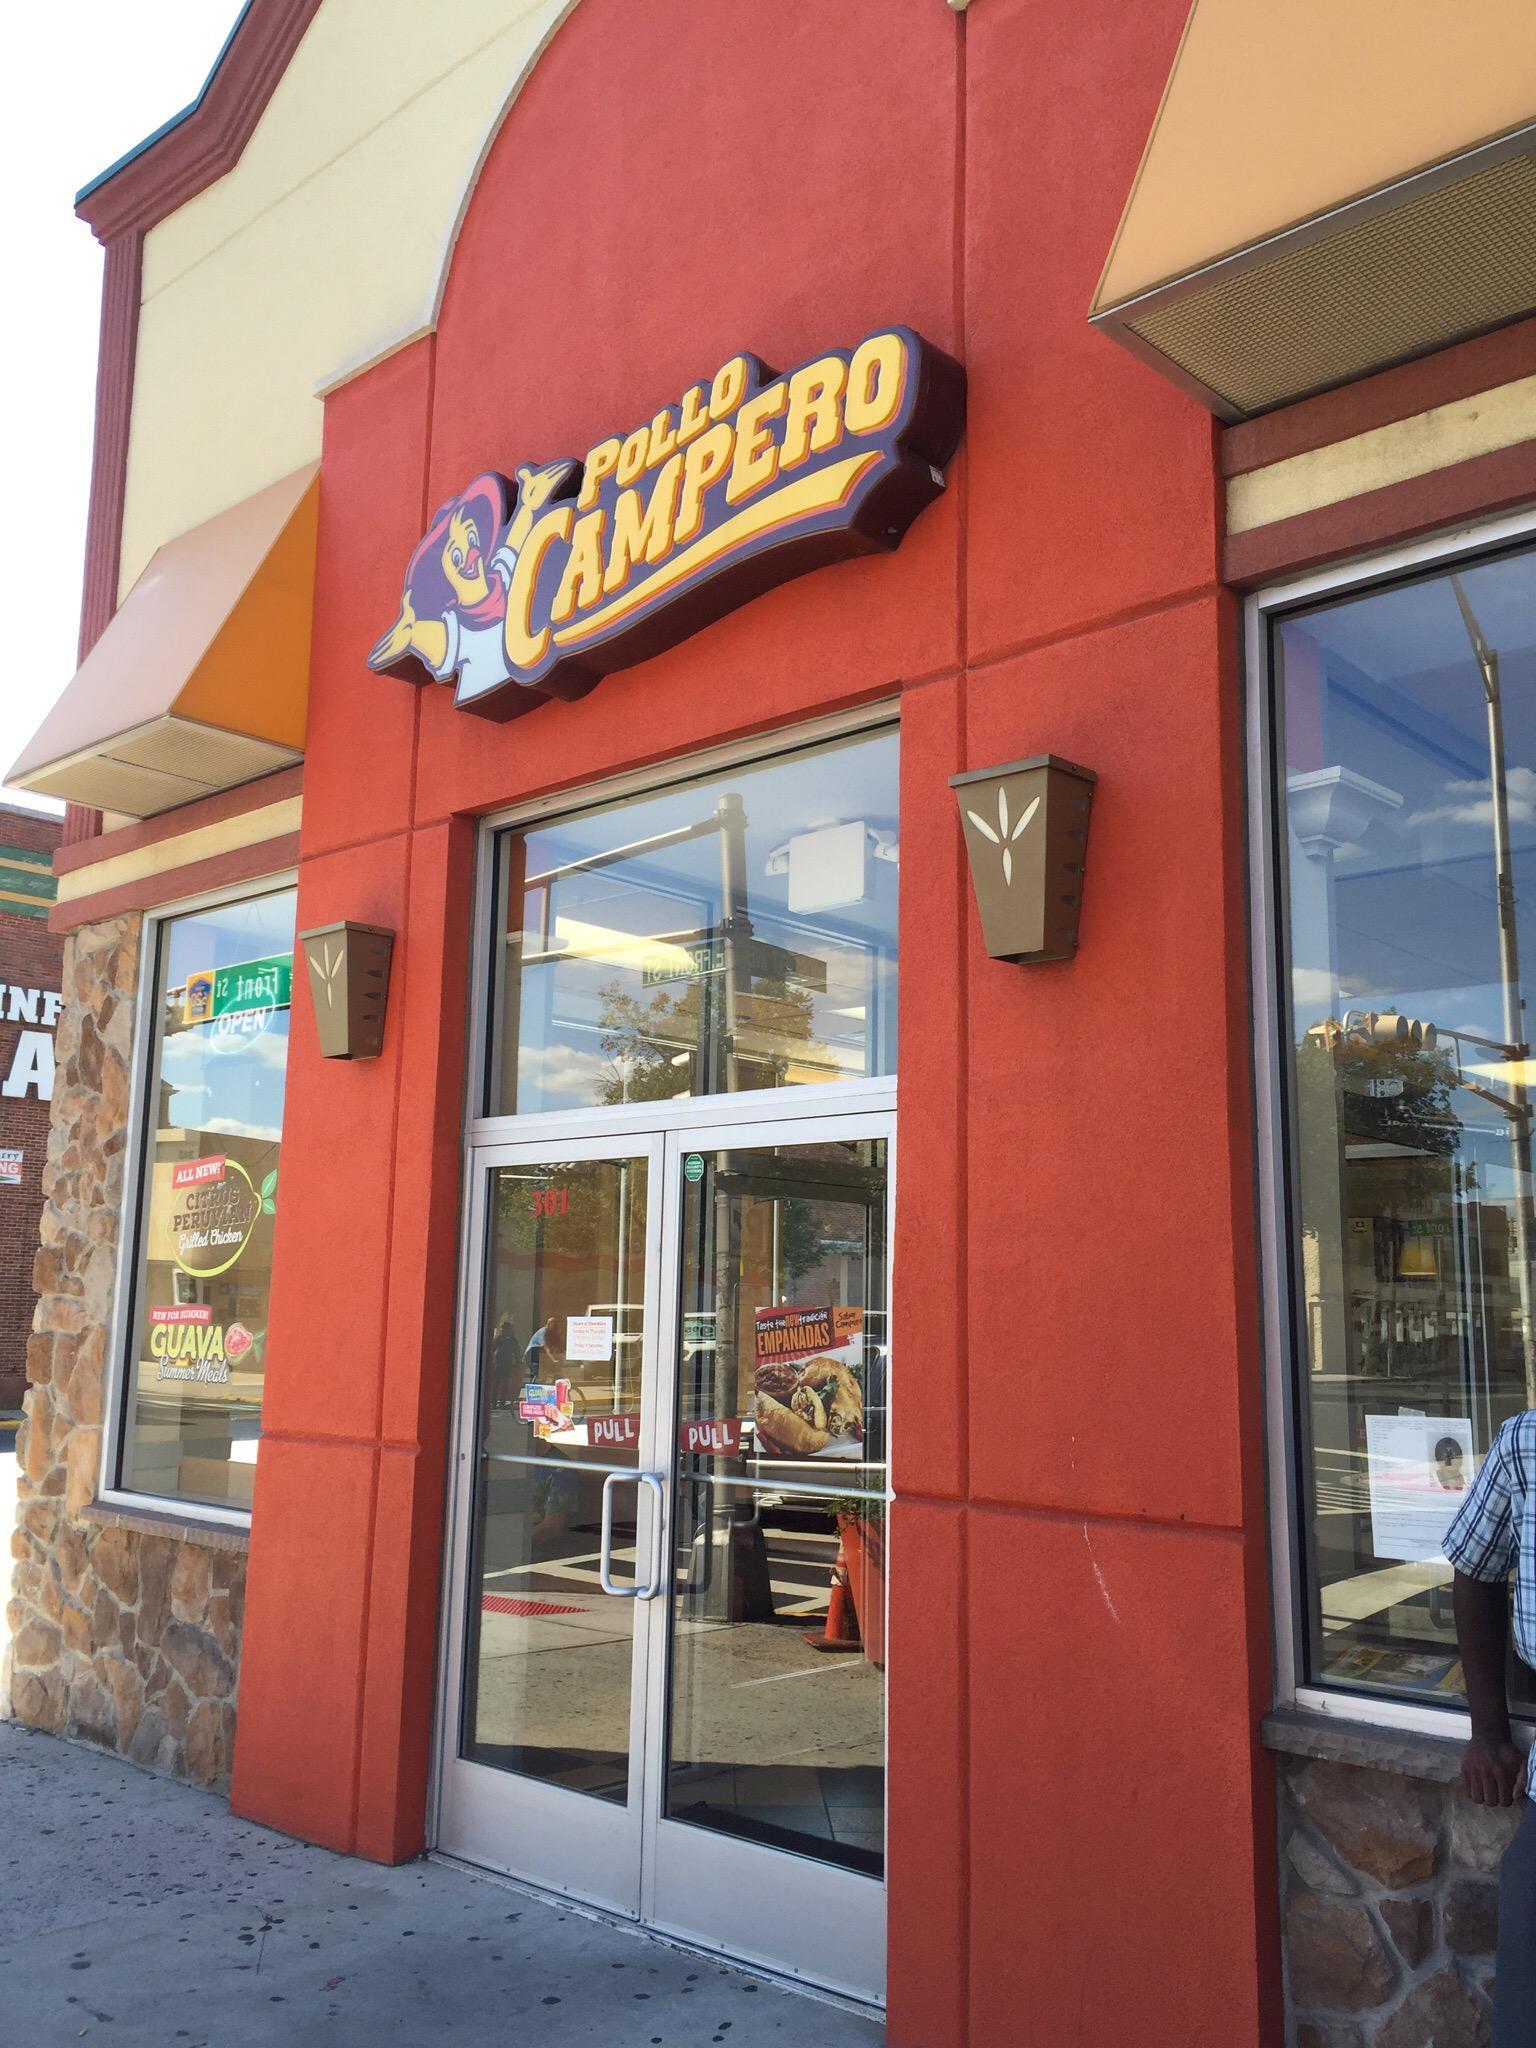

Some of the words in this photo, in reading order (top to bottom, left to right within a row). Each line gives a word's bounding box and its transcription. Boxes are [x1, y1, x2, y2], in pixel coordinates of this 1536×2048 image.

[577, 356, 748, 512] POLLO
[504, 333, 906, 669] CAMPERO
[217, 1008, 267, 1034] OPEN
[175, 1168, 194, 1183] ALL
[195, 1161, 223, 1179] NEW!
[185, 1188, 241, 1211] CITRUS
[173, 1202, 252, 1232] PERUVIAN
[178, 1230, 210, 1256] Grilled
[210, 1227, 243, 1246] Chicken
[152, 1310, 167, 1320] NEW
[167, 1310, 180, 1320] FOR
[756, 1320, 774, 1331] Taste
[150, 1323, 225, 1361] GUAVA
[757, 1322, 831, 1356] EMPANADAS
[156, 1354, 196, 1381] Summer
[196, 1357, 229, 1384] Meals
[594, 1418, 635, 1444] PULL
[688, 1424, 735, 1451] PULL
